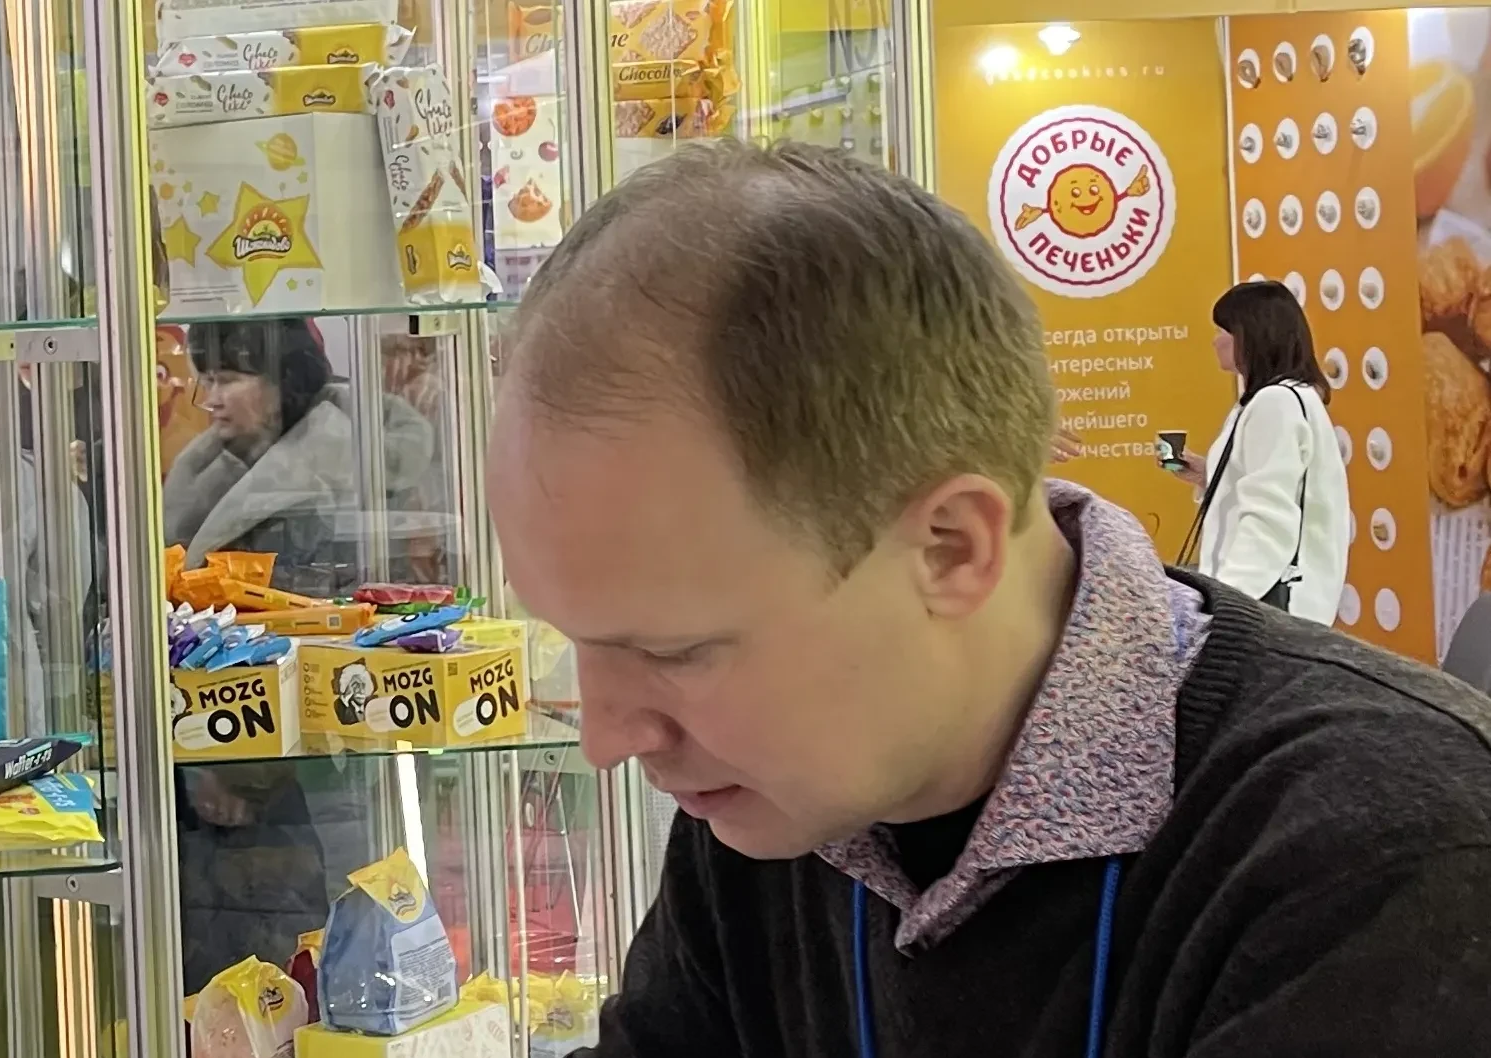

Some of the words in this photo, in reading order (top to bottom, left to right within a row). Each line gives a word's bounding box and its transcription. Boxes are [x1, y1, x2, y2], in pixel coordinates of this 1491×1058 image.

[1017, 129, 1134, 188] ДОБРЫЕ
[1028, 207, 1150, 273] ПЕЧЕНЬКИ
[1042, 328, 1097, 347] сегда
[1103, 324, 1189, 345] открыты
[1049, 355, 1154, 377] нтересных
[1056, 380, 1131, 402] ожений
[1062, 410, 1148, 430] нейшего
[1078, 441, 1155, 459] ичества
[382, 667, 434, 693] MOZG
[470, 658, 514, 694] MOZG
[199, 678, 266, 709] MOZG
[389, 688, 441, 728] ON
[475, 680, 519, 726] ON
[207, 700, 275, 743] ON
